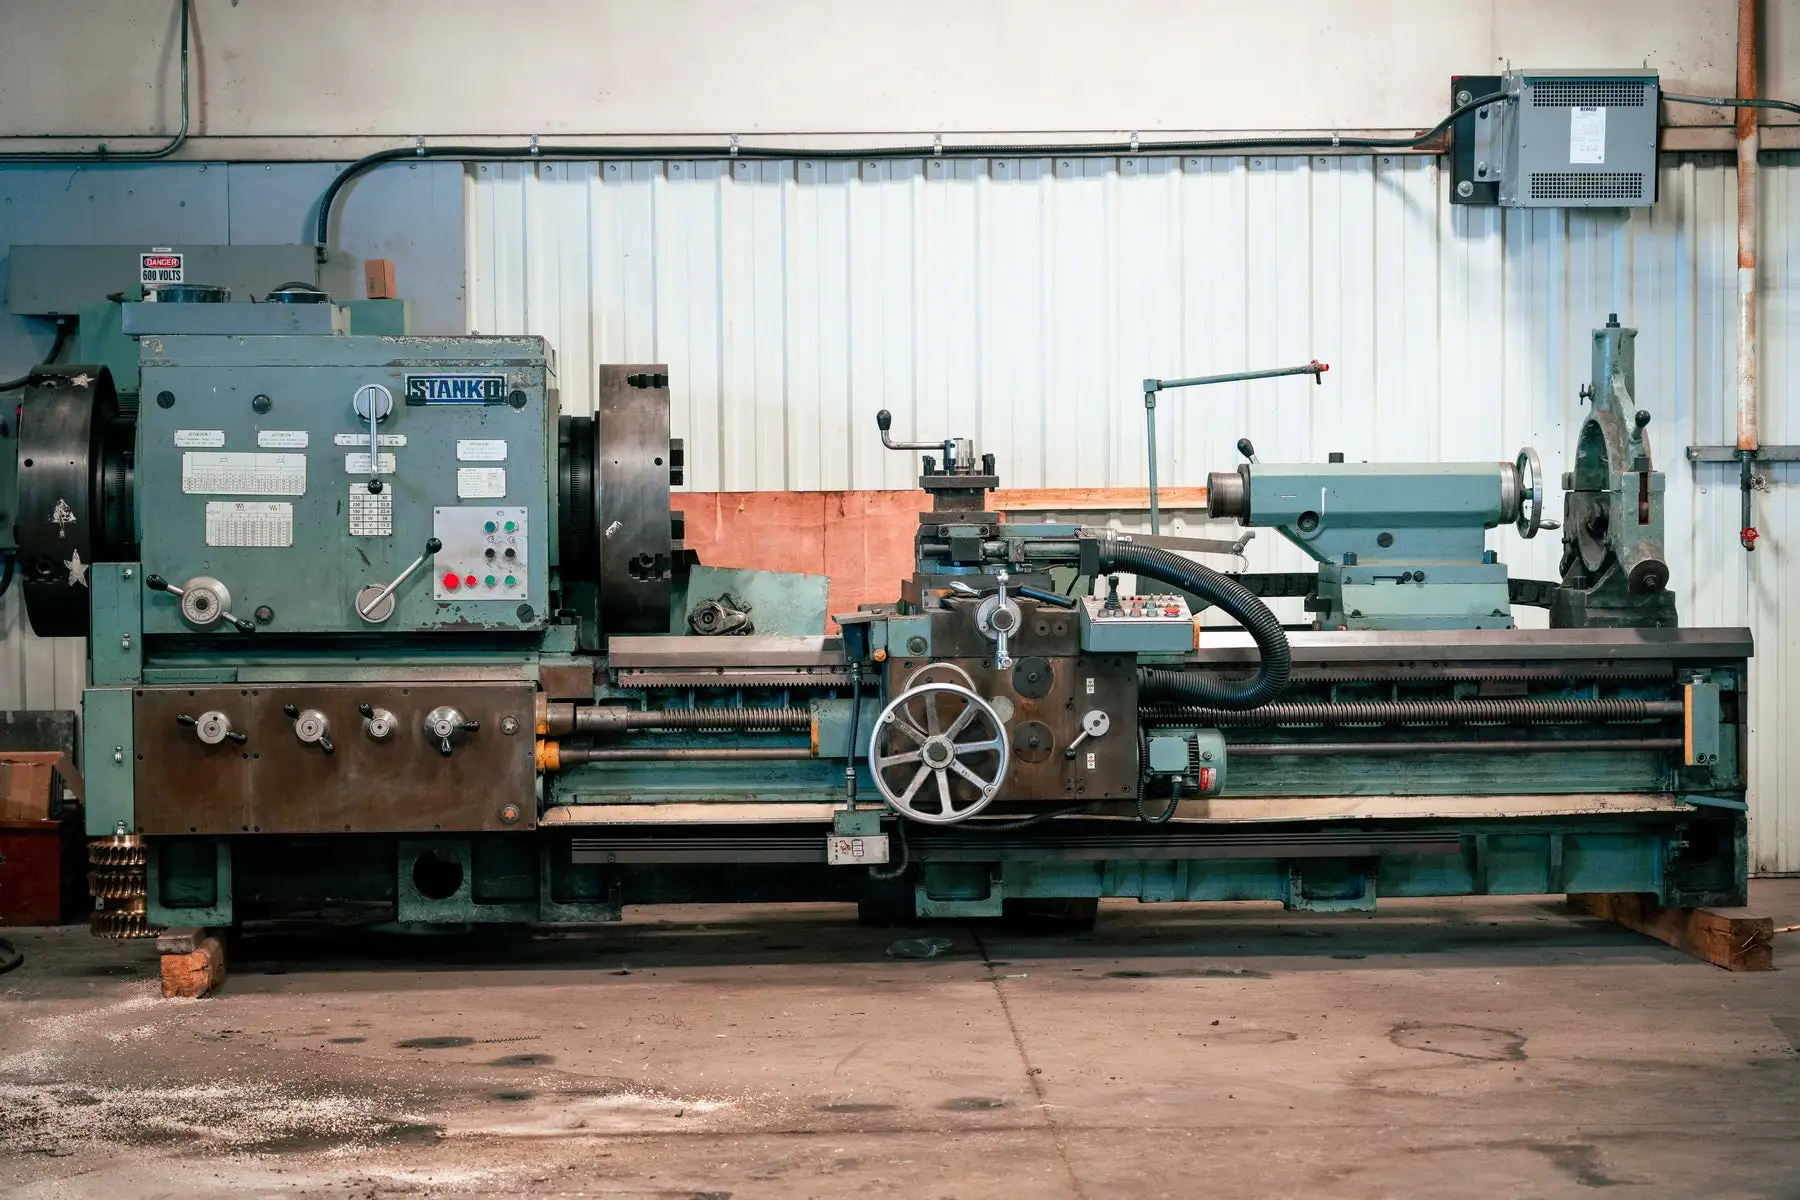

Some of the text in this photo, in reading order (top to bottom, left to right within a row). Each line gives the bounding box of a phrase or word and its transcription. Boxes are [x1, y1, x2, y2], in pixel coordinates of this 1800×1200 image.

[146, 258, 177, 266] DANGER
[143, 270, 181, 281] 600 VOLTS
[410, 379, 500, 399] STANKO
